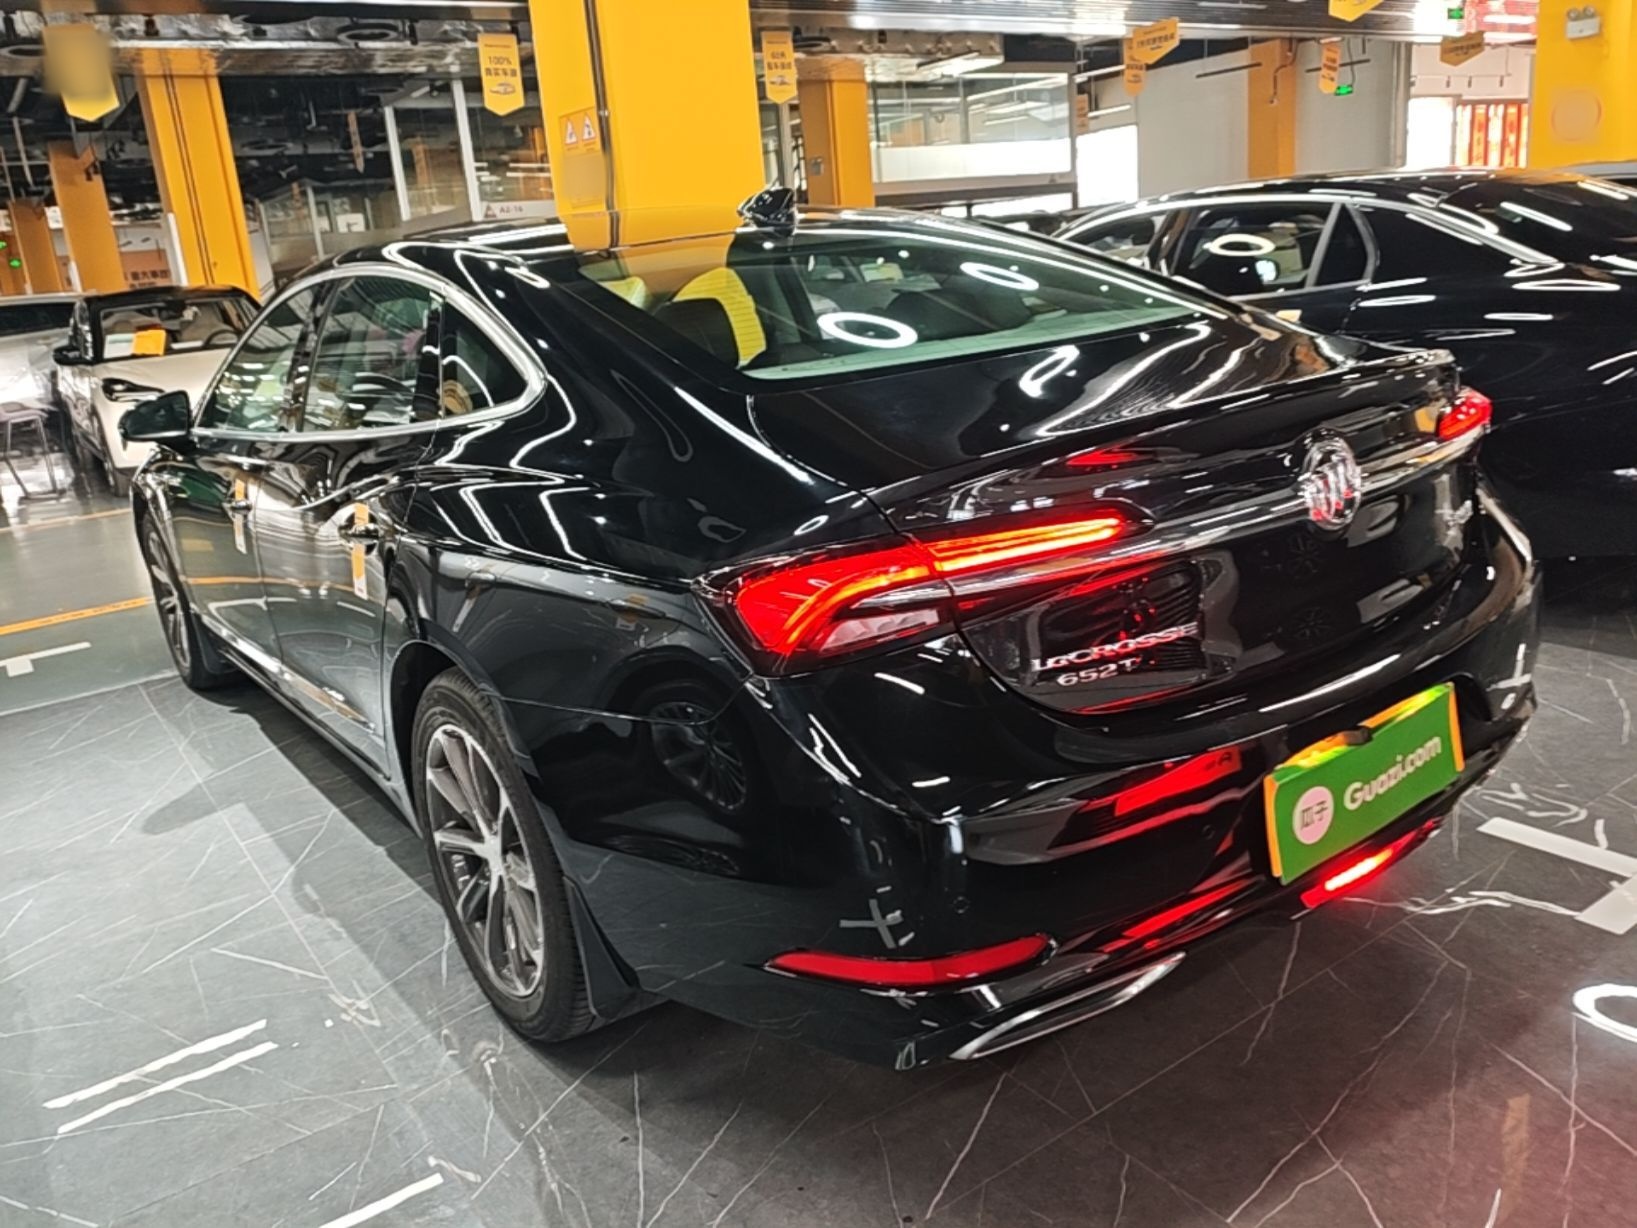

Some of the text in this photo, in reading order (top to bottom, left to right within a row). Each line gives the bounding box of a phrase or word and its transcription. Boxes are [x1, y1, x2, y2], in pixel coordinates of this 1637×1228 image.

[488, 56, 512, 65] 100%
[1057, 657, 1137, 687] 652T
[1344, 736, 1442, 811] Guazi.com
